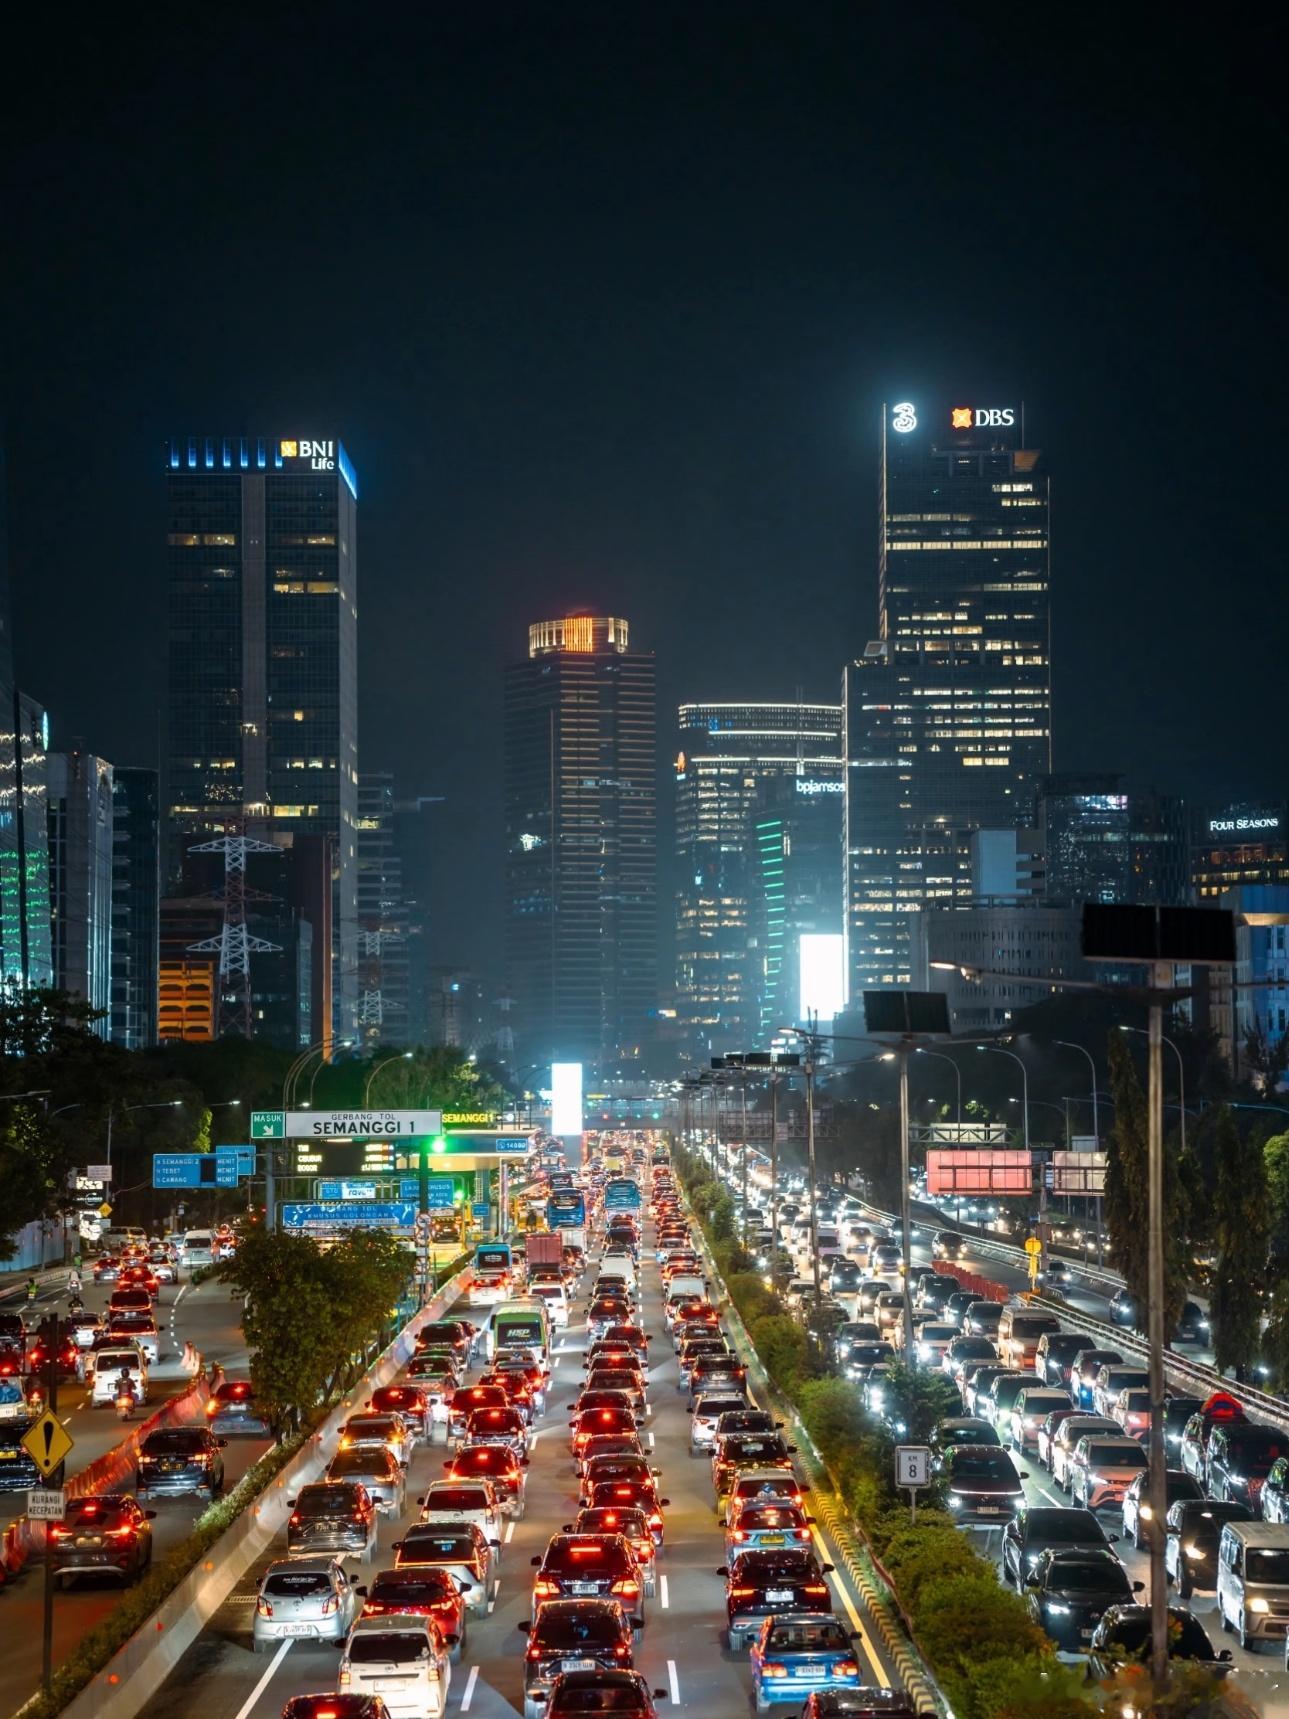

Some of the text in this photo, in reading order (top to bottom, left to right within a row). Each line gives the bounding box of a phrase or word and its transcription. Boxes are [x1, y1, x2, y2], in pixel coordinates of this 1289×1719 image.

[975, 408, 1015, 427] DBS
[299, 440, 333, 457] BNI
[311, 458, 335, 470] Life
[1209, 817, 1279, 832] FOUR SEASONS
[253, 1114, 282, 1122] MASUK
[331, 1113, 373, 1121] GERBANG
[442, 1113, 488, 1123] SEMANGGI
[313, 1121, 415, 1135] SEMANGGI 1
[909, 1464, 917, 1478] 8
[31, 1495, 60, 1504] KURANGI
[28, 1506, 62, 1515] KECEPATAN
